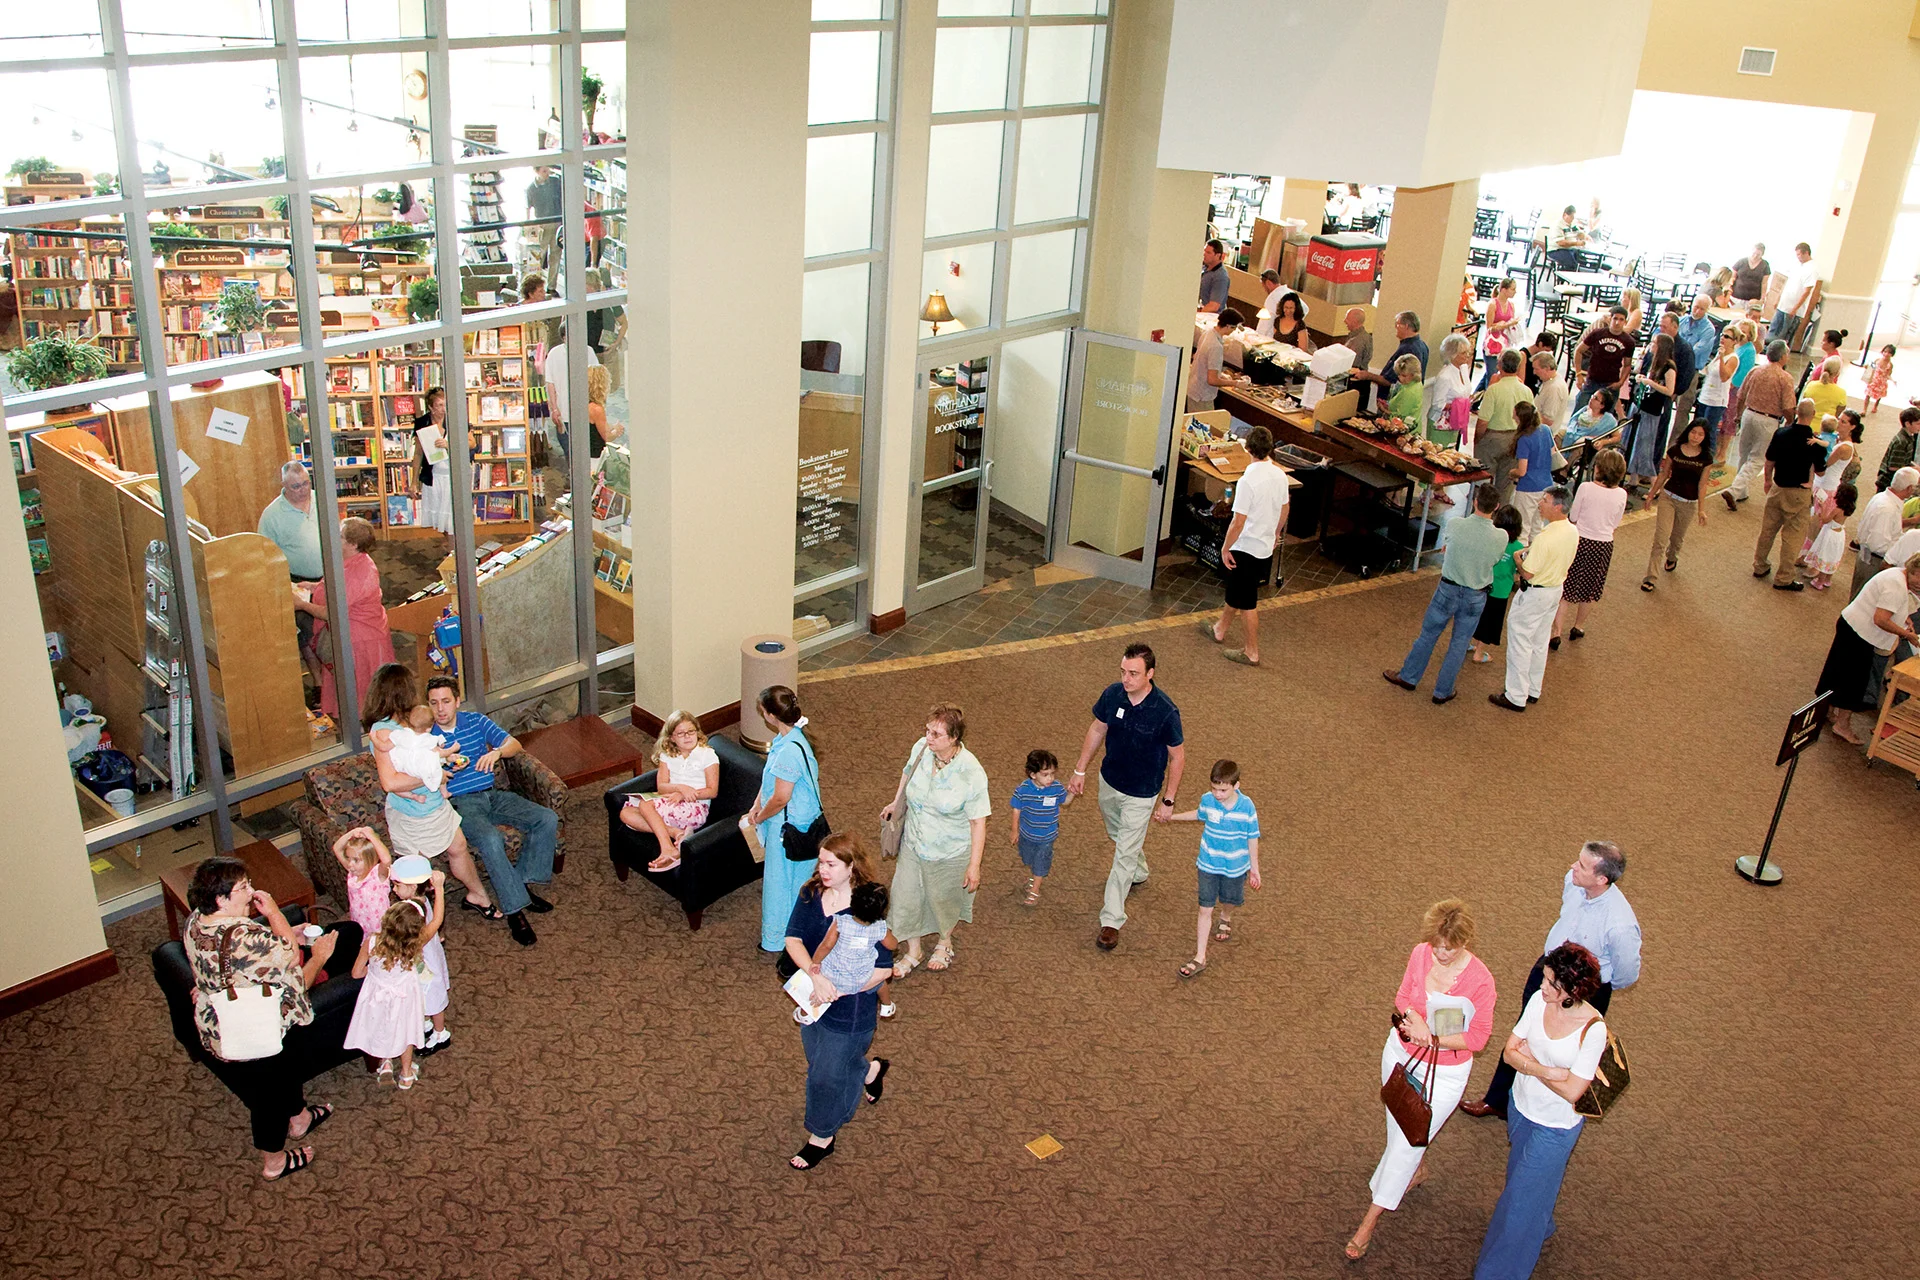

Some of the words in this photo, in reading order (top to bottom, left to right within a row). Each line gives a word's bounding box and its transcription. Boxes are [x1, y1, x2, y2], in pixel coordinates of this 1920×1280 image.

[209, 209, 237, 217] Christian
[238, 209, 258, 217] Living
[183, 254, 199, 262] Love
[200, 254, 206, 262] &
[208, 254, 238, 263] Marriage
[1343, 257, 1372, 272] Coca-Cola
[934, 416, 977, 434] BOOKSTORE
[799, 453, 829, 466] Bookstore
[830, 448, 849, 458] Hours
[814, 462, 833, 472] Monday
[799, 481, 818, 491] Tuesday
[823, 473, 847, 484] Thursday
[815, 492, 830, 502] Friday
[811, 507, 833, 518] Saturday
[812, 522, 831, 532] Sunday
